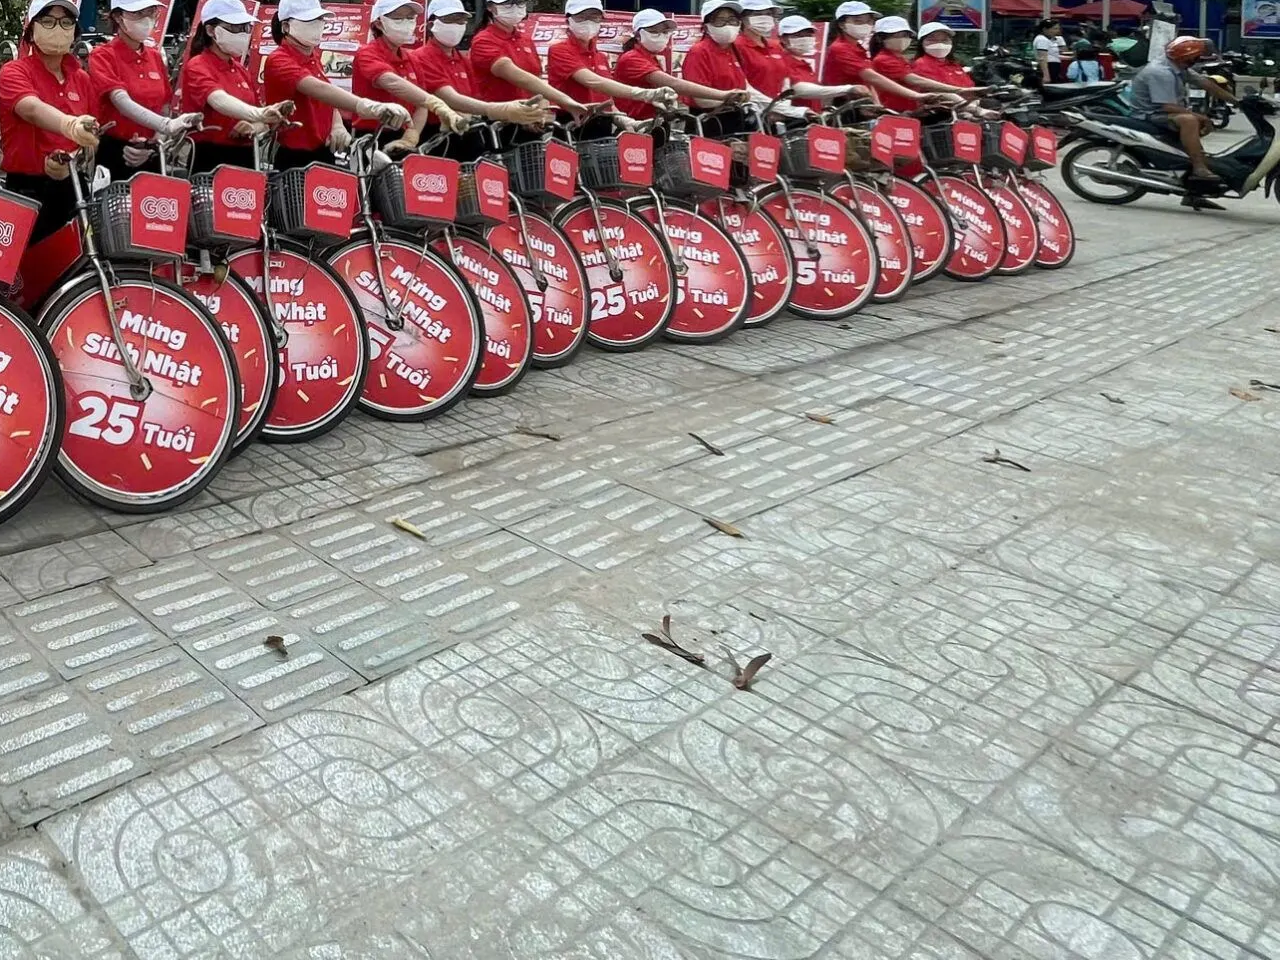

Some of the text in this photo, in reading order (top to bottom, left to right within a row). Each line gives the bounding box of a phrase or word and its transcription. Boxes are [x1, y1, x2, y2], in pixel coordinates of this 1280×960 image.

[323, 21, 343, 36] 25
[535, 29, 554, 41] 25
[598, 26, 618, 38] 25
[140, 195, 179, 222] GO!
[221, 186, 257, 211] GO!
[502, 248, 532, 269] Sin
[580, 248, 607, 266] inh
[678, 244, 721, 267] Nhật
[796, 260, 856, 285] 5 Tuổi
[390, 264, 448, 312] Mừng
[689, 288, 729, 306] Tuổi
[274, 301, 327, 326] Nhật
[530, 294, 573, 327] 5 Tuổi
[590, 283, 660, 322] 25 Tuổi
[119, 309, 188, 351] Mừng
[403, 300, 453, 344] Nhật
[143, 350, 203, 387] Nhật
[292, 355, 339, 382] Tuổi
[368, 326, 433, 391] 5 Tuổi
[68, 395, 197, 454] 25 Tuổi
